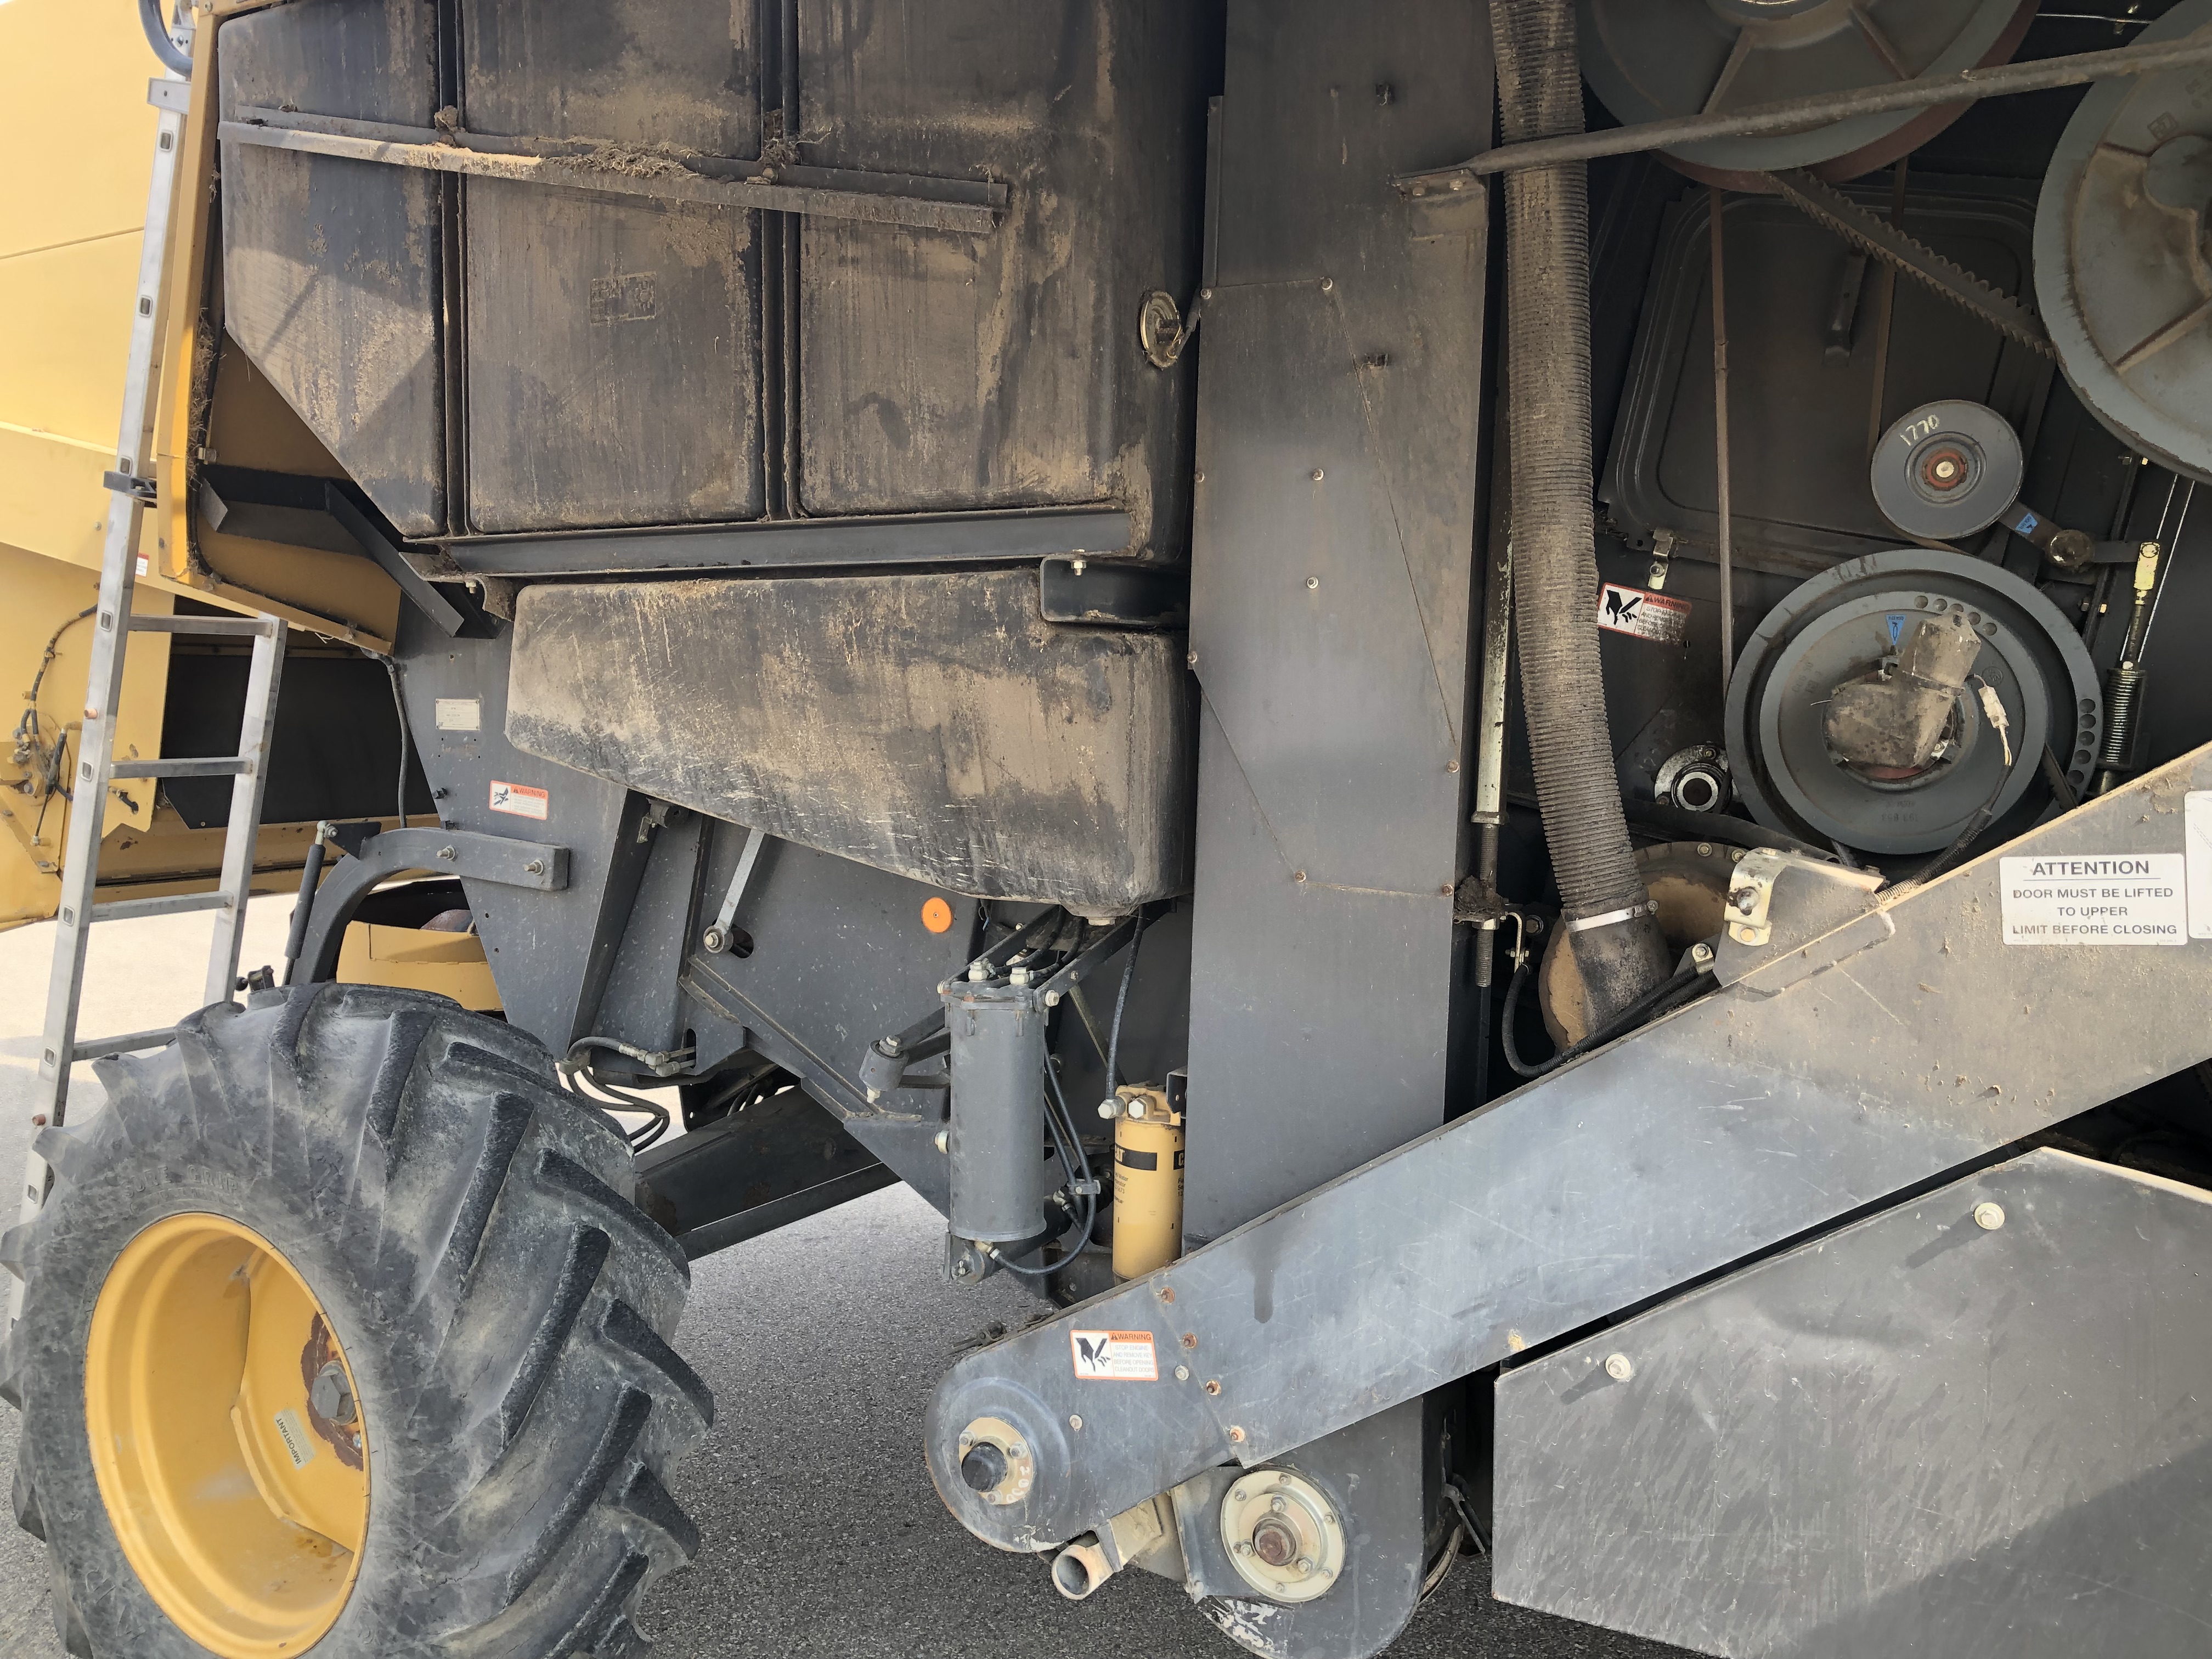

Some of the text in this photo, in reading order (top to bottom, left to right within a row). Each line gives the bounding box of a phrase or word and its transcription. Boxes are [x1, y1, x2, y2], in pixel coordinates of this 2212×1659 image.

[1899, 414, 1940, 446] 1770
[1654, 596, 1689, 610] WARNING
[518, 787, 545, 798] WARNING
[2033, 860, 2149, 876] ATTENTION
[2013, 888, 2173, 898] DOOR MUST BE LIFTED
[2057, 907, 2128, 916] TO UPPER
[2013, 924, 2177, 934] LIMIT BEFORE CLOSING
[122, 1164, 172, 1199] SURE
[276, 1418, 302, 1465] IMPORTANT
